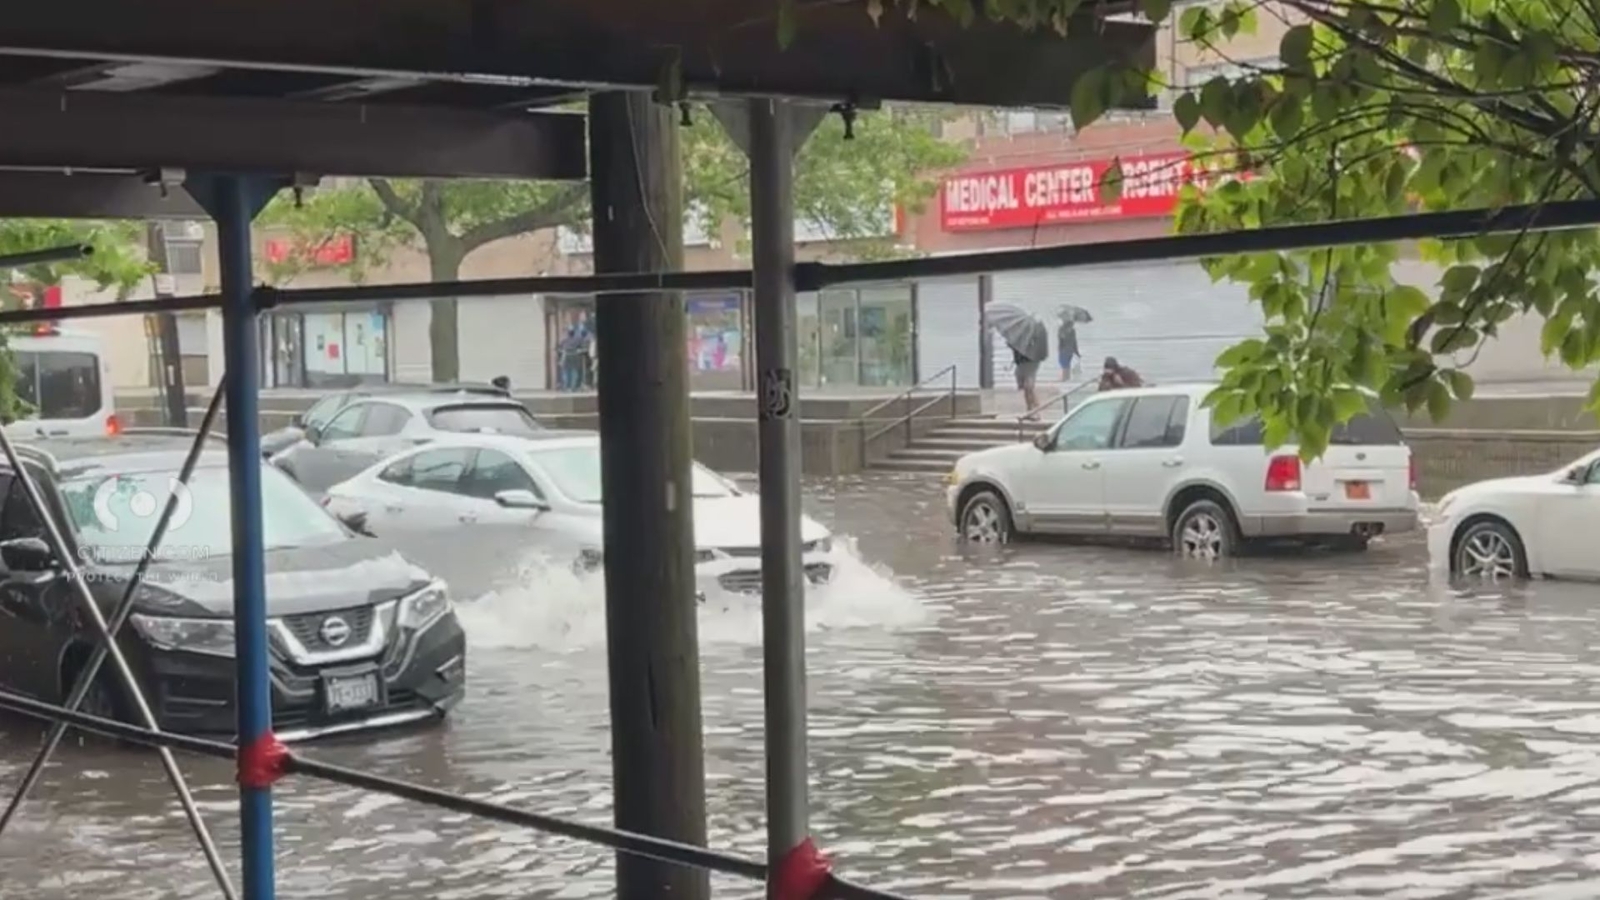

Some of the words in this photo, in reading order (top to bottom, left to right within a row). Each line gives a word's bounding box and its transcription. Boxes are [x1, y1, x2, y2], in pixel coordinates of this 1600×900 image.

[946, 174, 1019, 212] MEDICAL
[1024, 167, 1095, 207] CENTER
[1108, 156, 1189, 199] RGENT
